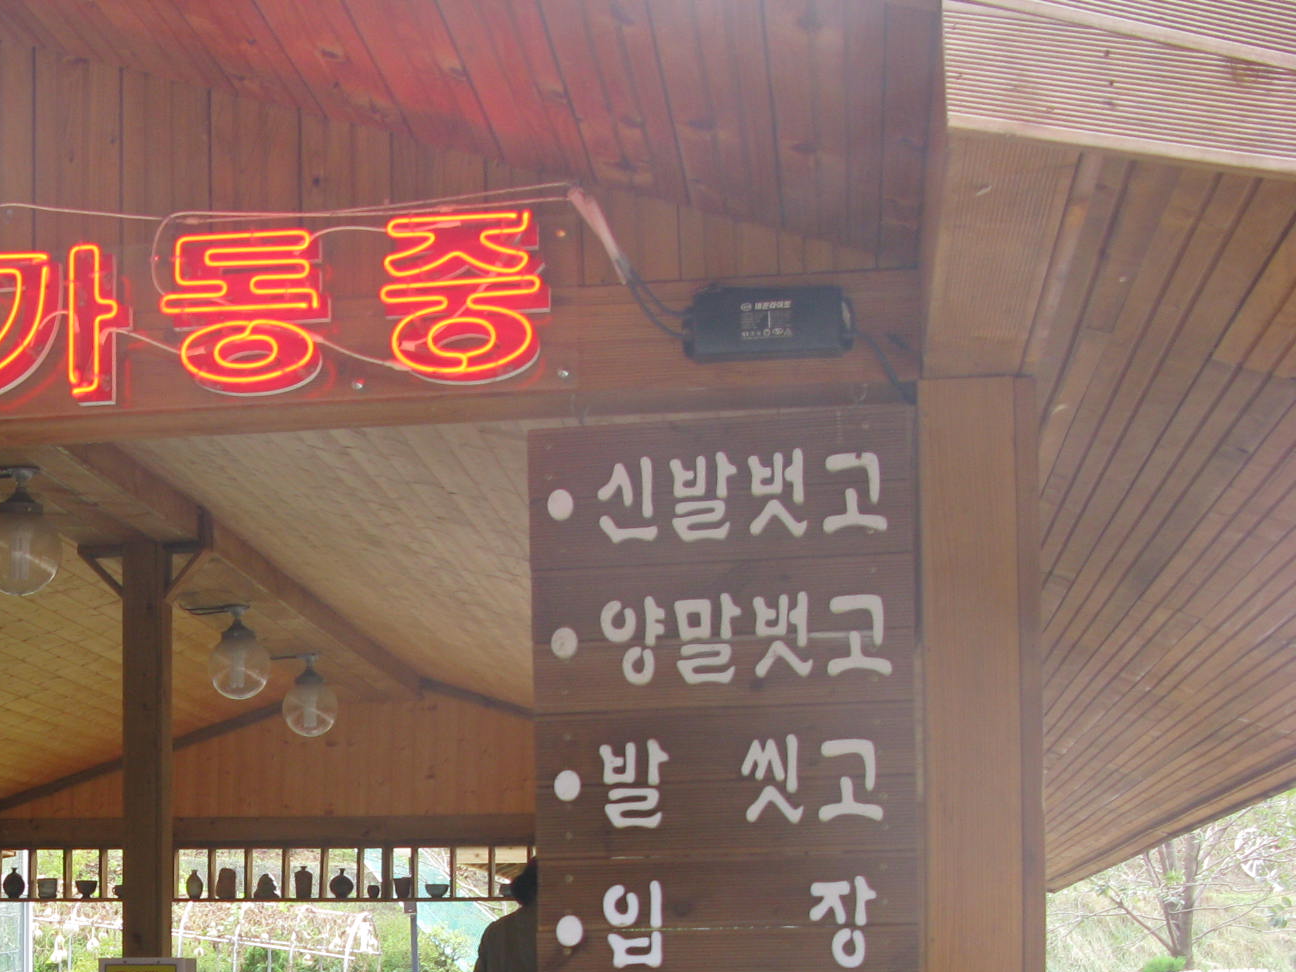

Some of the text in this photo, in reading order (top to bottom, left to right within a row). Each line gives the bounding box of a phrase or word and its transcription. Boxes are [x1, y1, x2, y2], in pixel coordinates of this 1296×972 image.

[597, 447, 887, 543] 신발벗고
[600, 591, 892, 685] 양말벗고
[599, 733, 883, 829] 발 씻고
